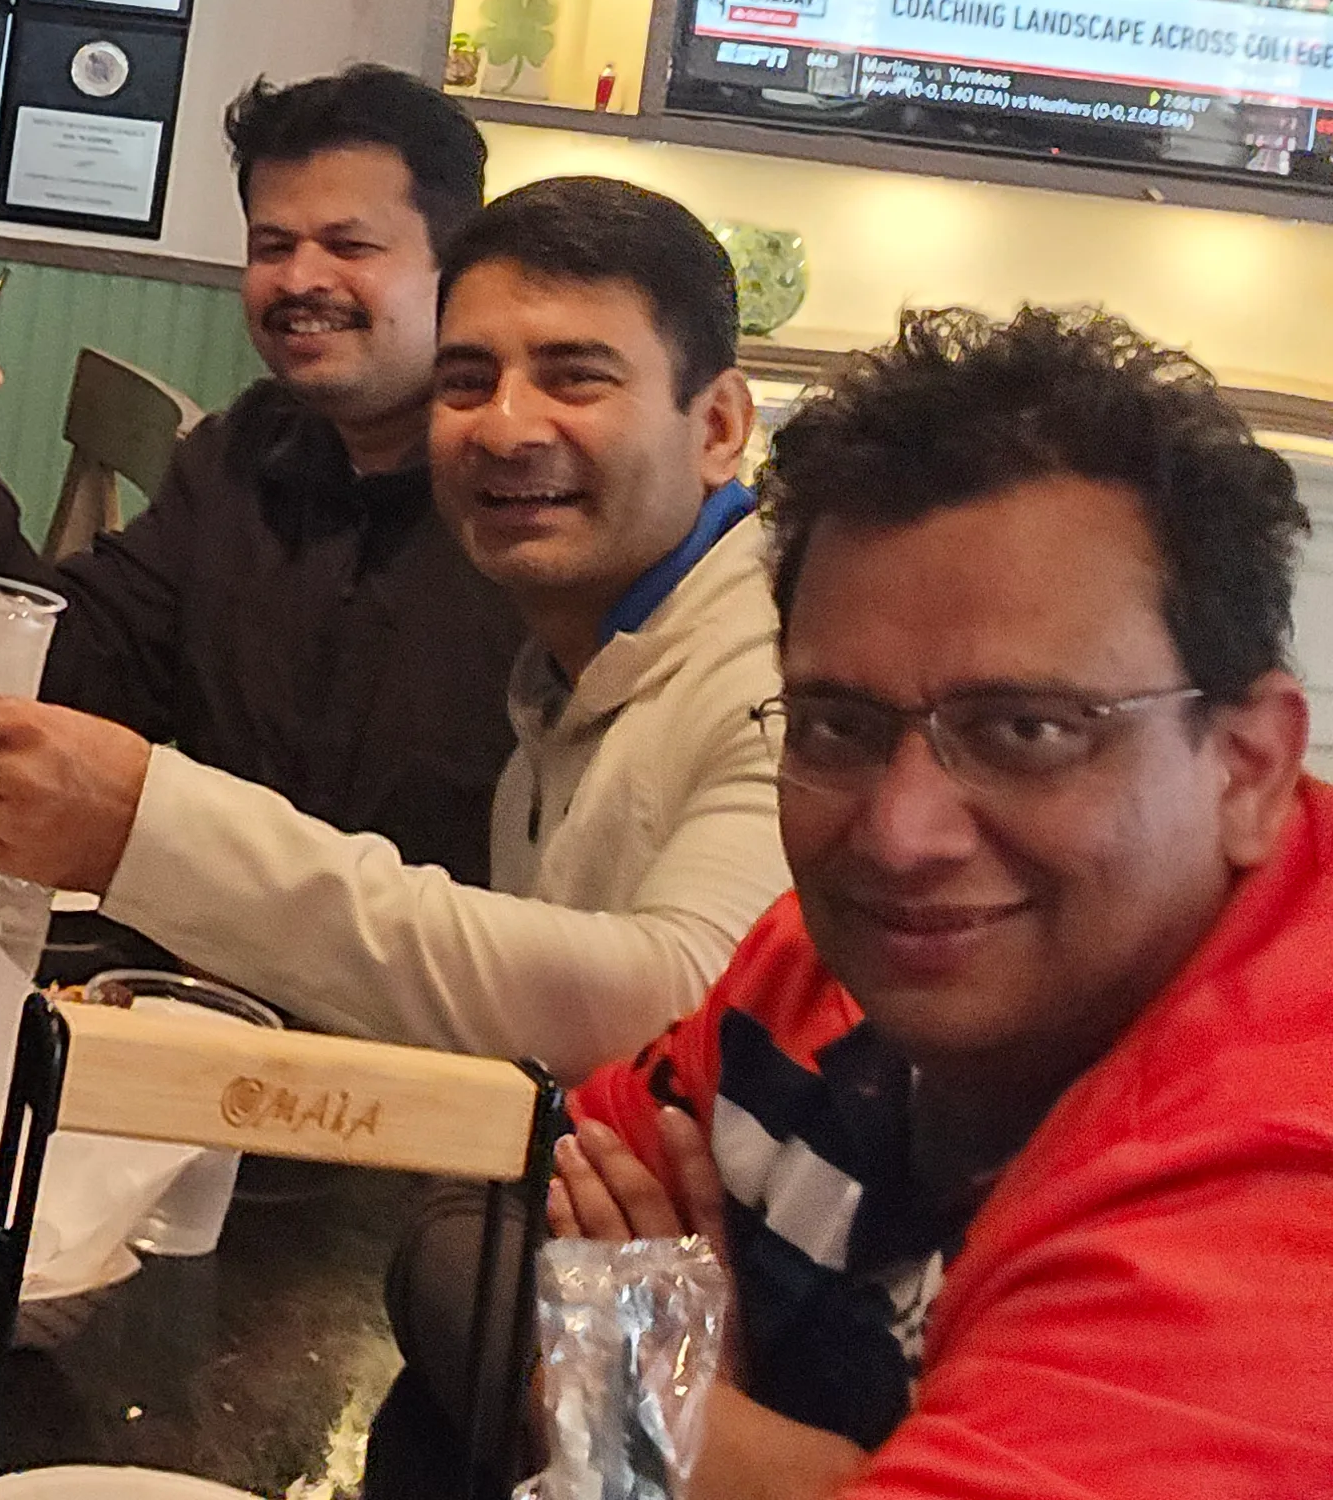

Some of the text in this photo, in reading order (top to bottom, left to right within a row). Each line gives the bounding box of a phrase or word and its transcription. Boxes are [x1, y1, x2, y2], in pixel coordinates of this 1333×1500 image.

[1014, 6, 1144, 45] LANDSCAPE
[1150, 22, 1237, 56] ACROSS
[716, 41, 790, 69] ESPN
[948, 66, 1013, 89] Yankees
